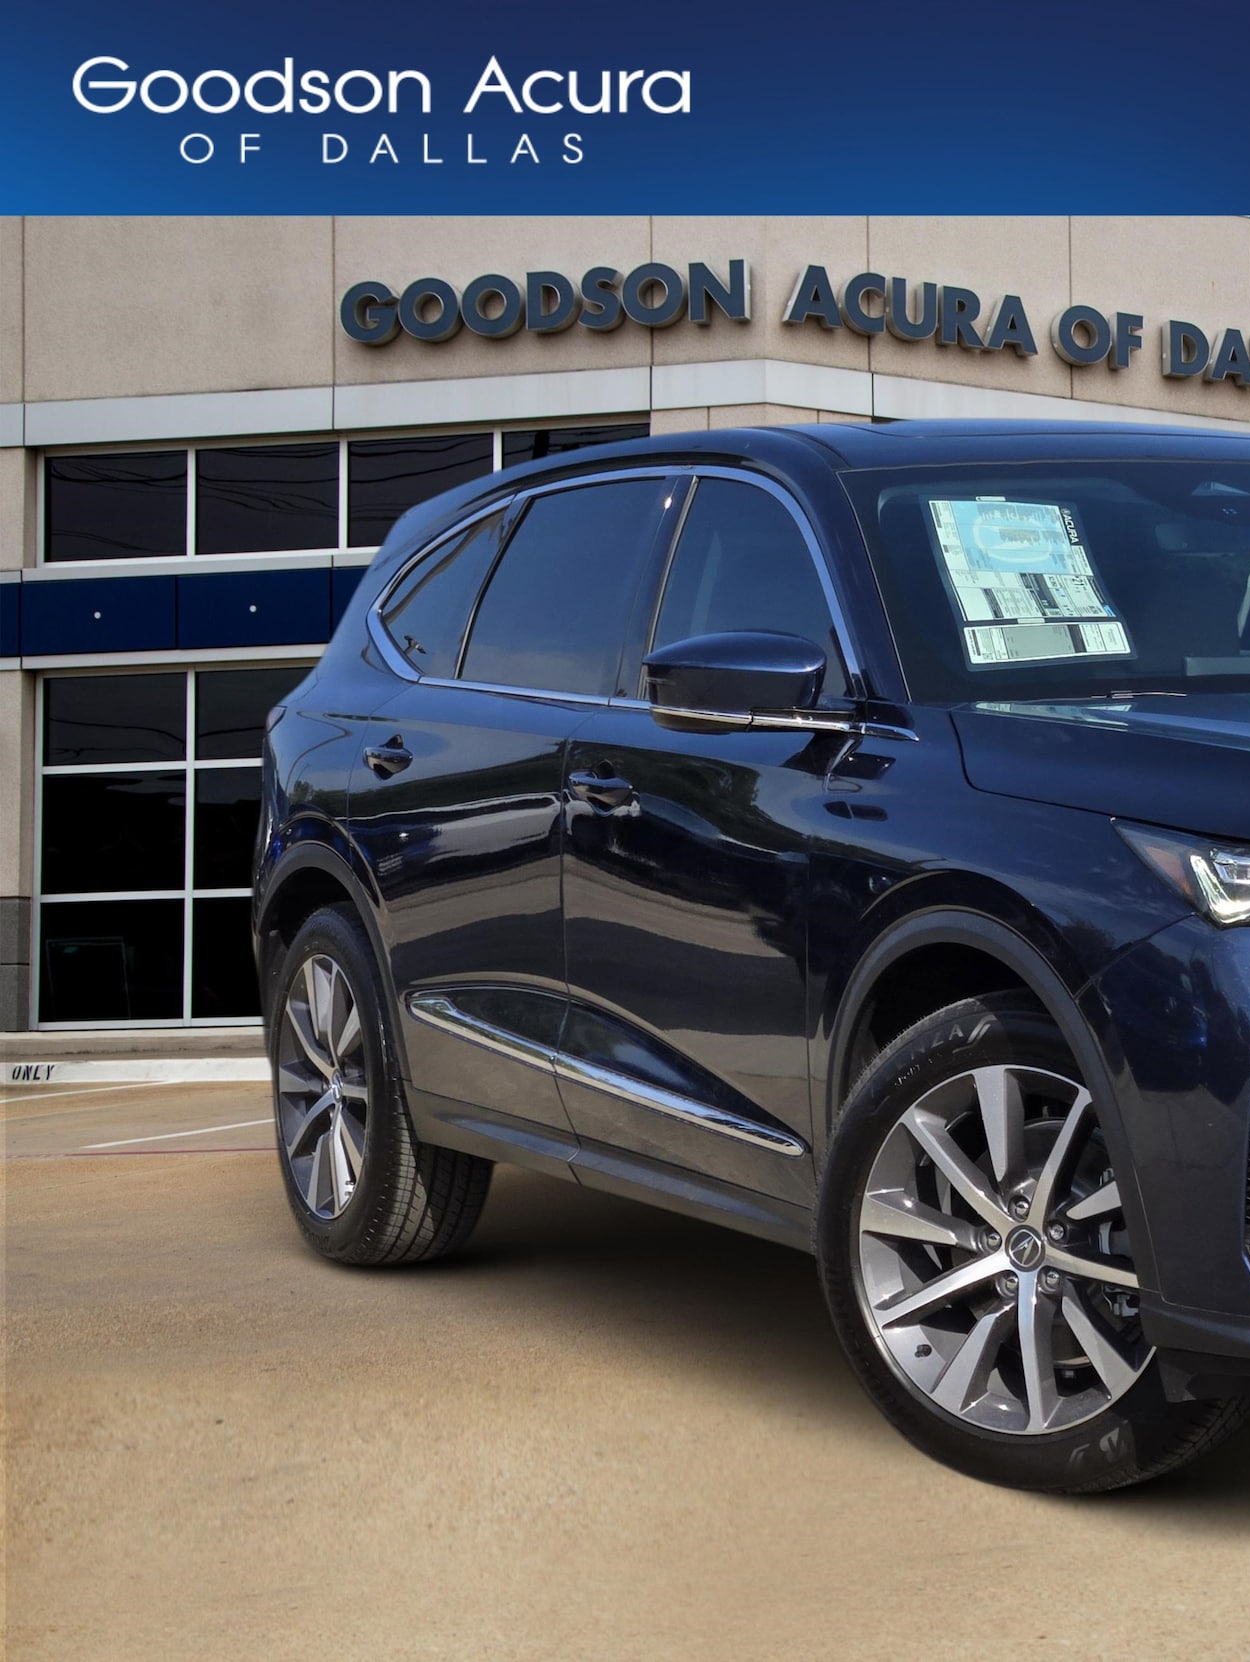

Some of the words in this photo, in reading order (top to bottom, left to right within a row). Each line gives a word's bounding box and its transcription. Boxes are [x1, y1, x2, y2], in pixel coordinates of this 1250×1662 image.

[340, 258, 752, 347] GOODSON
[782, 264, 1038, 356] ACURA
[1051, 305, 1144, 370] OF
[1063, 514, 1079, 544] ACURA
[12, 1065, 55, 1081] ONLY
